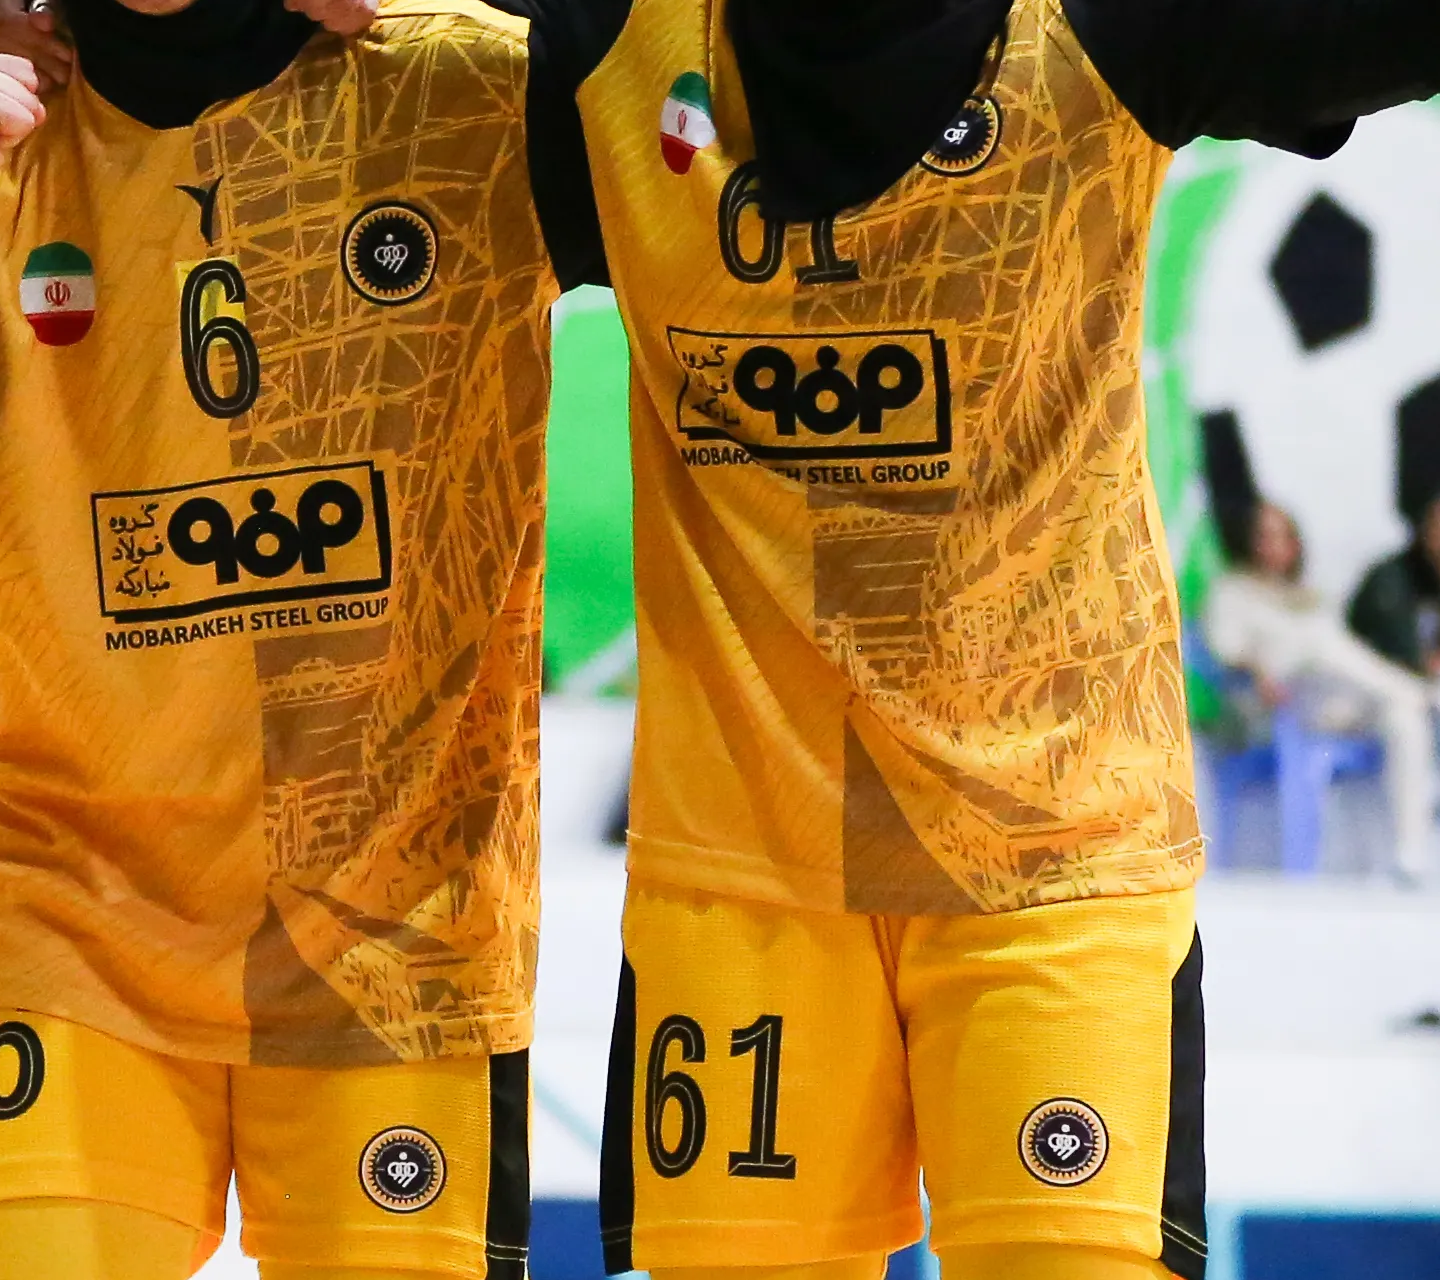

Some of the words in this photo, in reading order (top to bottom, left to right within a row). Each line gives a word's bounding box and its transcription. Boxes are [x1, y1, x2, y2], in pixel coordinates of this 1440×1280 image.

[179, 258, 260, 419] 6
[807, 466, 868, 485] STEEL
[871, 460, 951, 484] GROUP
[105, 615, 244, 651] MOBARAKEH
[250, 606, 312, 633] STEEL
[316, 596, 389, 623] GROUP
[645, 1014, 796, 1180] 61
